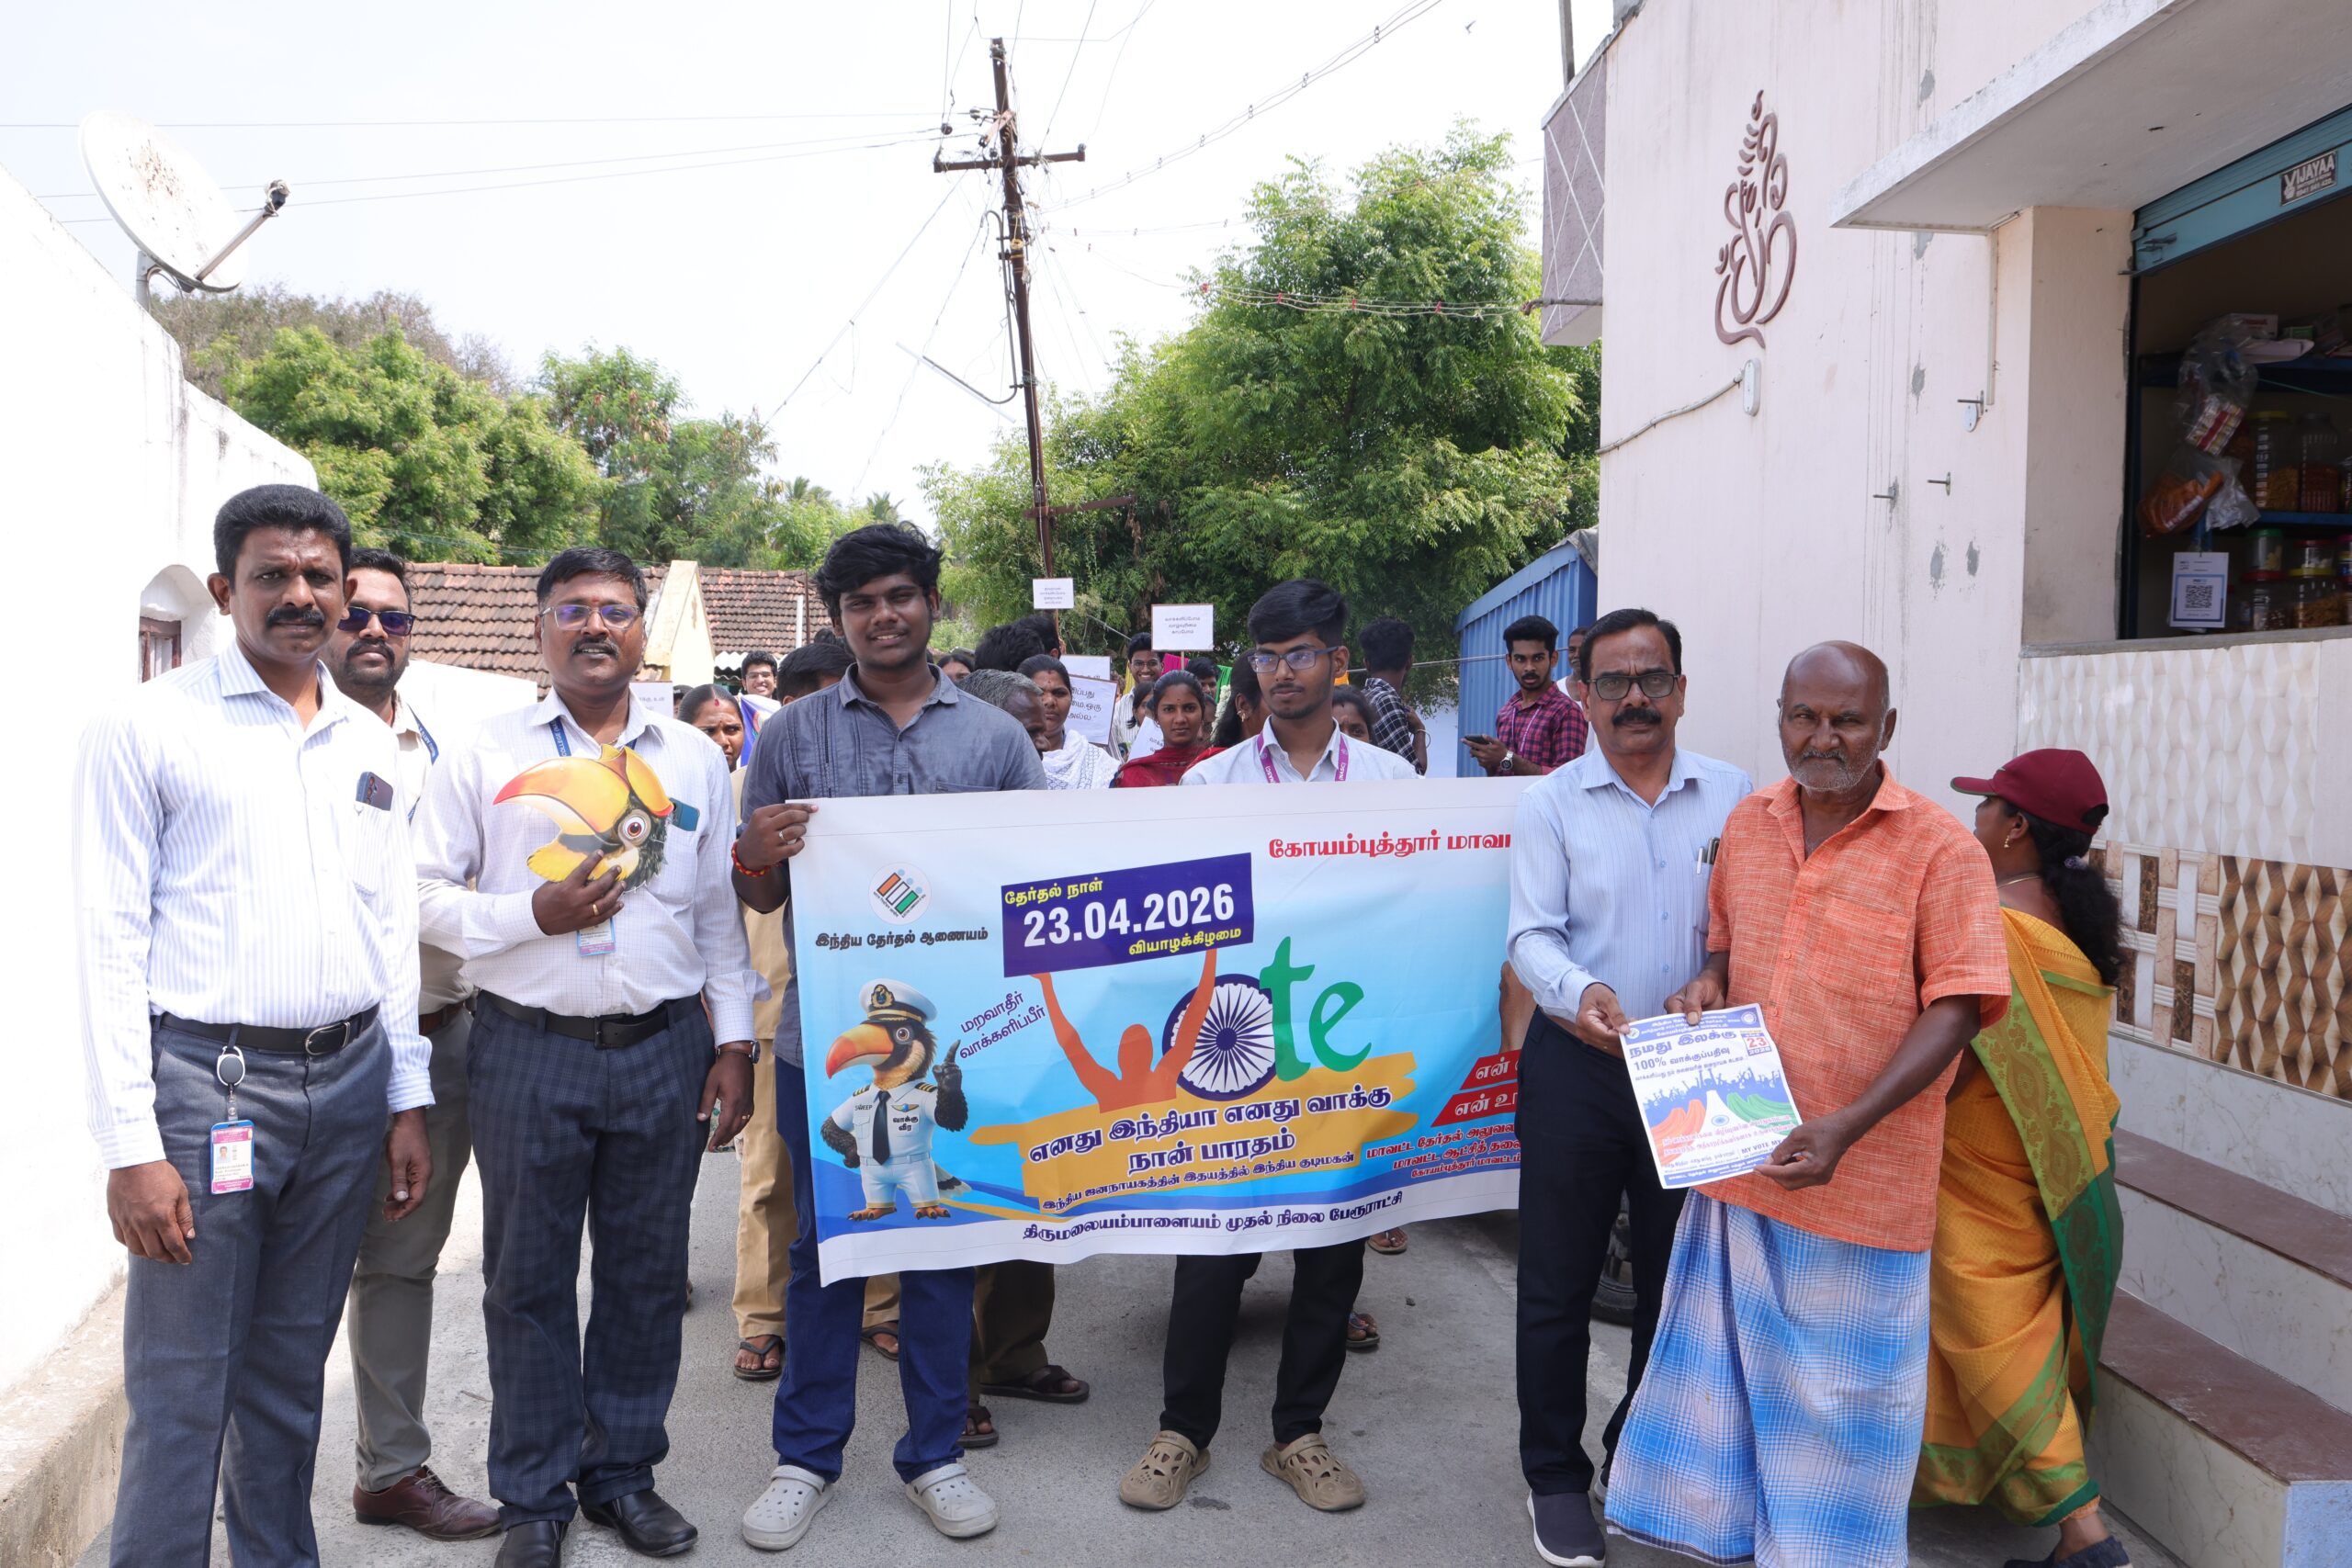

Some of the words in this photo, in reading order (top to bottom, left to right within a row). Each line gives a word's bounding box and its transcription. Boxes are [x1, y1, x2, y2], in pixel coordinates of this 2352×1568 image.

[1269, 829, 1441, 858] கோயம்புத்தூர்
[1004, 883, 1062, 907] தேர்தல்
[1067, 876, 1103, 899] நாள்
[1023, 883, 1235, 948] 23.04.2026
[816, 932, 863, 951] இந்திய
[866, 930, 916, 949] தேர்தல்
[919, 927, 989, 945] ஆணையம்
[1128, 928, 1242, 955] வியாழக்கிழமை
[960, 990, 1024, 1033] மறவாதீர்
[959, 1004, 1046, 1059] வாக்களிப்பீர்
[1629, 1039, 1673, 1059] நமது
[1678, 1030, 1737, 1046] இலக்கு
[1747, 1037, 1768, 1048] 23
[1476, 1056, 1511, 1079] என்
[1634, 1056, 1667, 1071] 100%
[1454, 1093, 1491, 1117] என்
[1029, 1129, 1102, 1162] எனது
[1109, 1110, 1217, 1143] இந்தியா
[1225, 1099, 1300, 1122] எனது
[1306, 1084, 1392, 1113] வாக்கு
[1128, 1140, 1194, 1175] நான்
[1201, 1126, 1295, 1161] பாரதம்
[1366, 1142, 1414, 1159] மாவட்ட
[1417, 1129, 1464, 1148] தேர்தல்
[1393, 1152, 1441, 1169] மாவட்ட
[1442, 1140, 1487, 1160] ஆட்சித்
[1043, 1192, 1082, 1212] இந்திய
[1085, 1174, 1180, 1197] ஜனநாயகத்தின்
[1183, 1164, 1250, 1183] இதயத்தில்
[1252, 1158, 1296, 1174] இந்திய
[1299, 1151, 1355, 1168] குடிமகன்
[1411, 1158, 1476, 1179] கோயம்புத்தூர்
[1023, 1213, 1221, 1242] திருமலையம்பாளையம்
[1226, 1210, 1273, 1232] முதல்
[1276, 1208, 1326, 1227] நிலை
[1329, 1190, 1403, 1222] பேரூராட்சி
